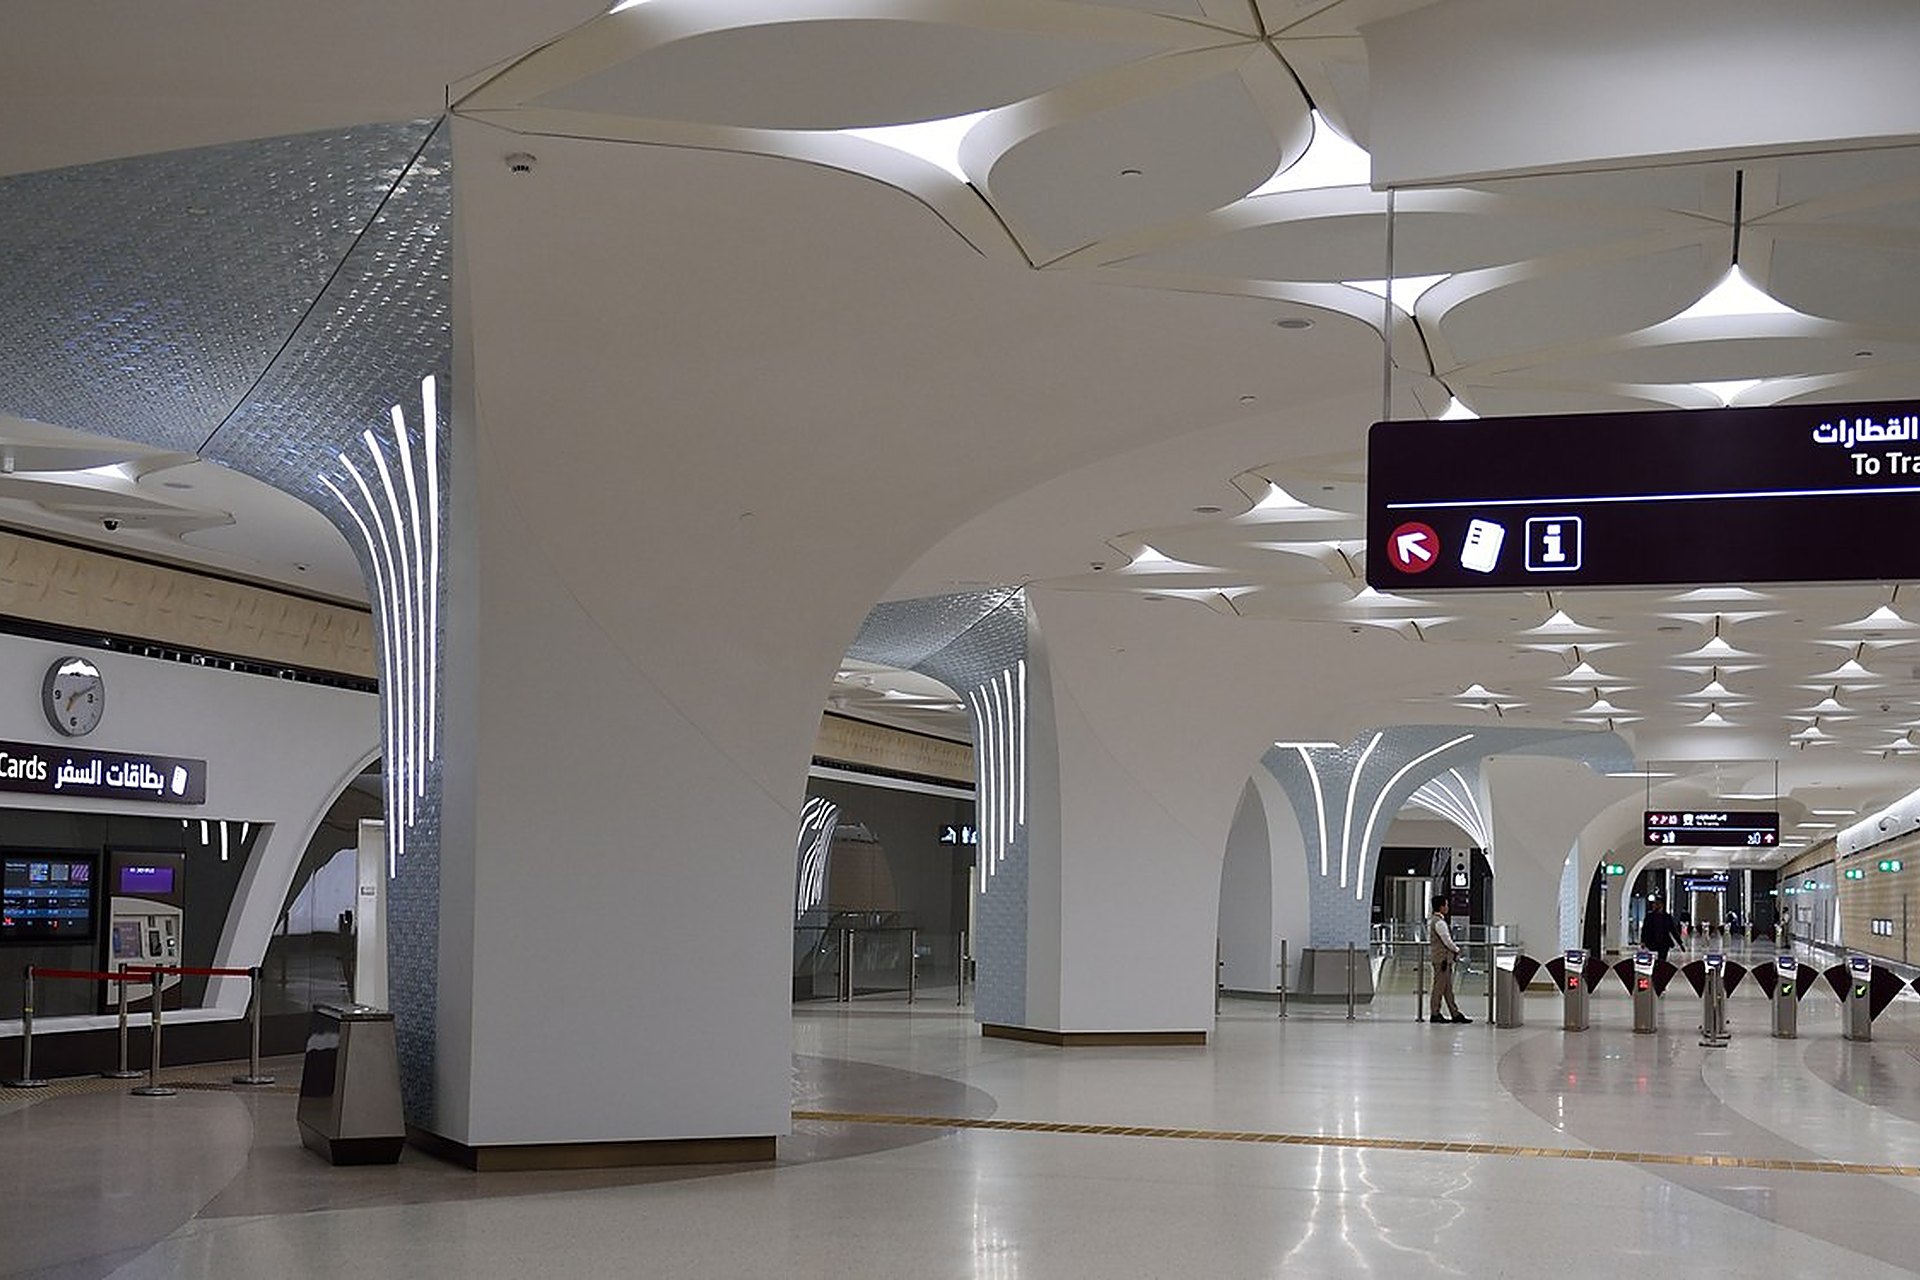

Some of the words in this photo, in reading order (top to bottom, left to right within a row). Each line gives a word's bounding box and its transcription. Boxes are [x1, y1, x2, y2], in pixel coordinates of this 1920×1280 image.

[1812, 415, 1919, 449] القطارات
[1850, 453, 1881, 476] To
[54, 689, 62, 700] 9
[87, 693, 94, 703] 3
[0, 752, 47, 780] Cards
[54, 758, 102, 789] السفر
[105, 762, 165, 795] بطاقات
